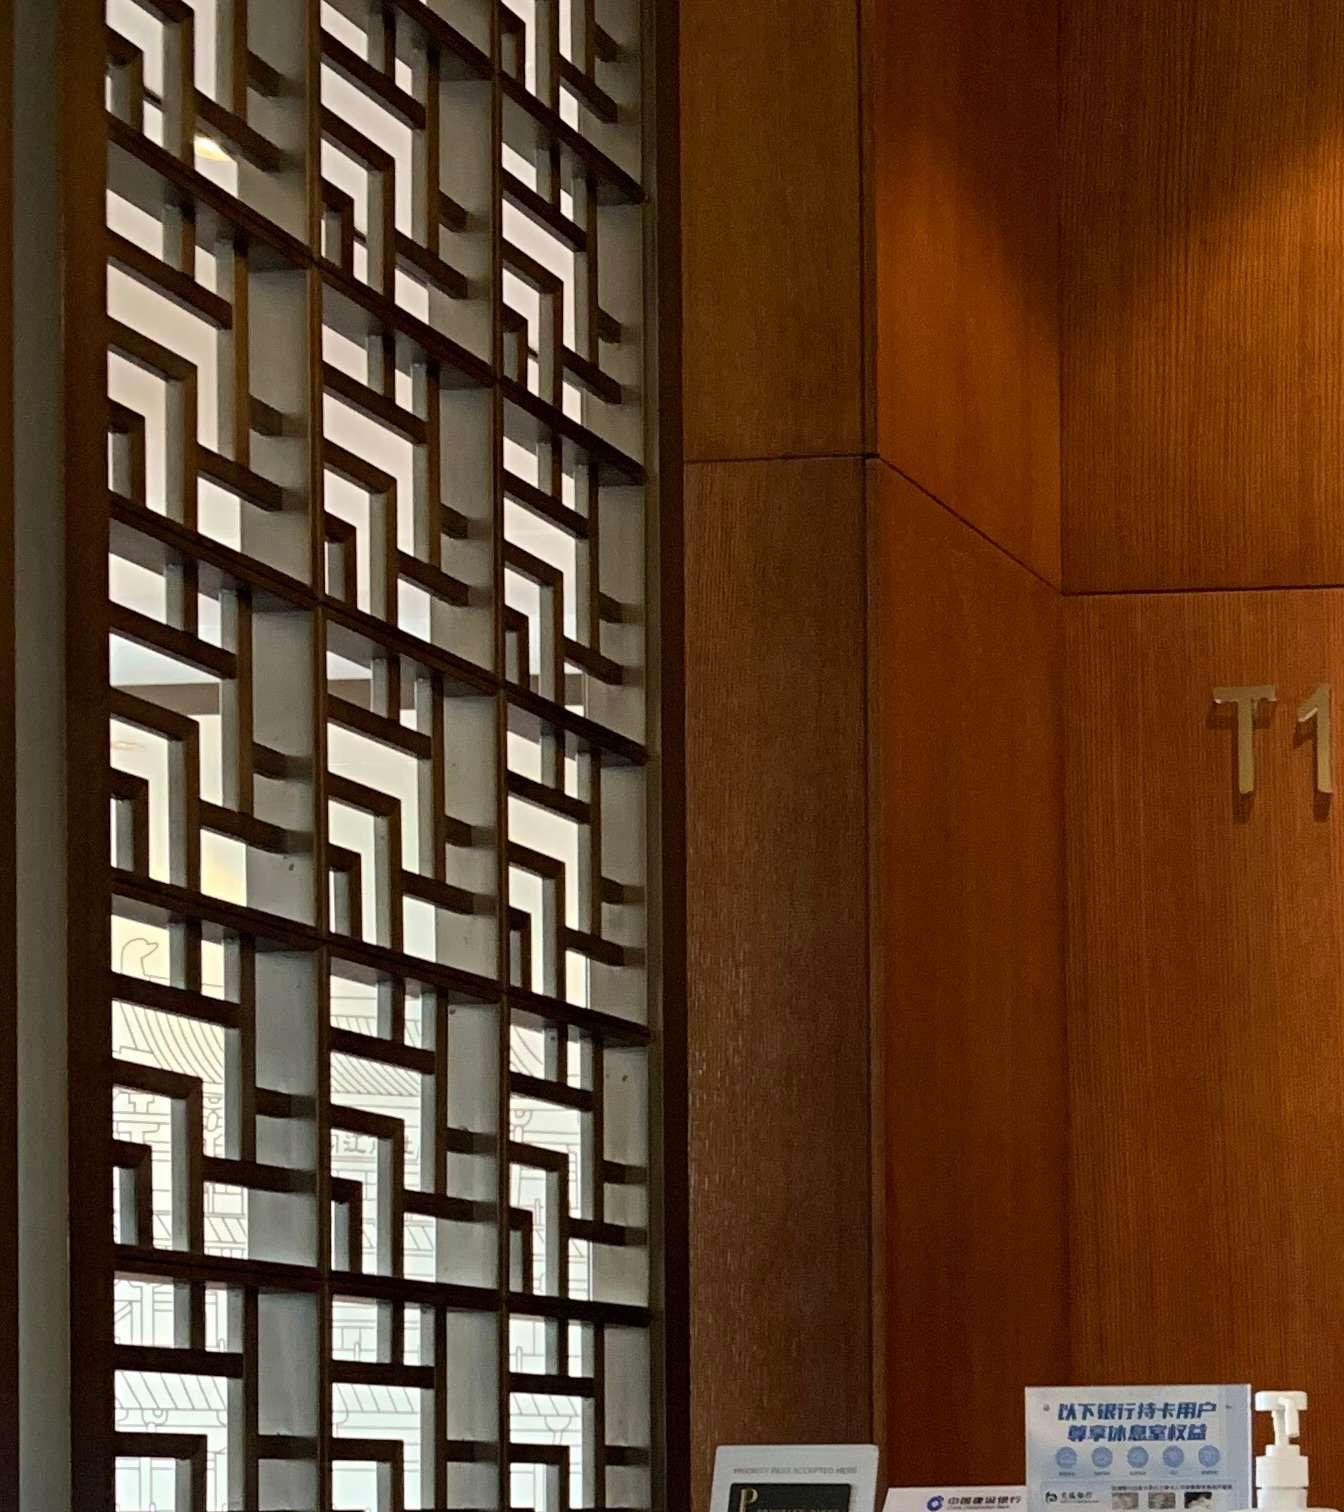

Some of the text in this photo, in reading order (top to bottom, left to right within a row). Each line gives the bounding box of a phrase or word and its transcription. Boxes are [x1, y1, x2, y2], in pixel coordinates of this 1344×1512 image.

[1057, 1401, 1217, 1421] 以下银行持卡用户
[1067, 1423, 1208, 1442] 尊享休息室权益
